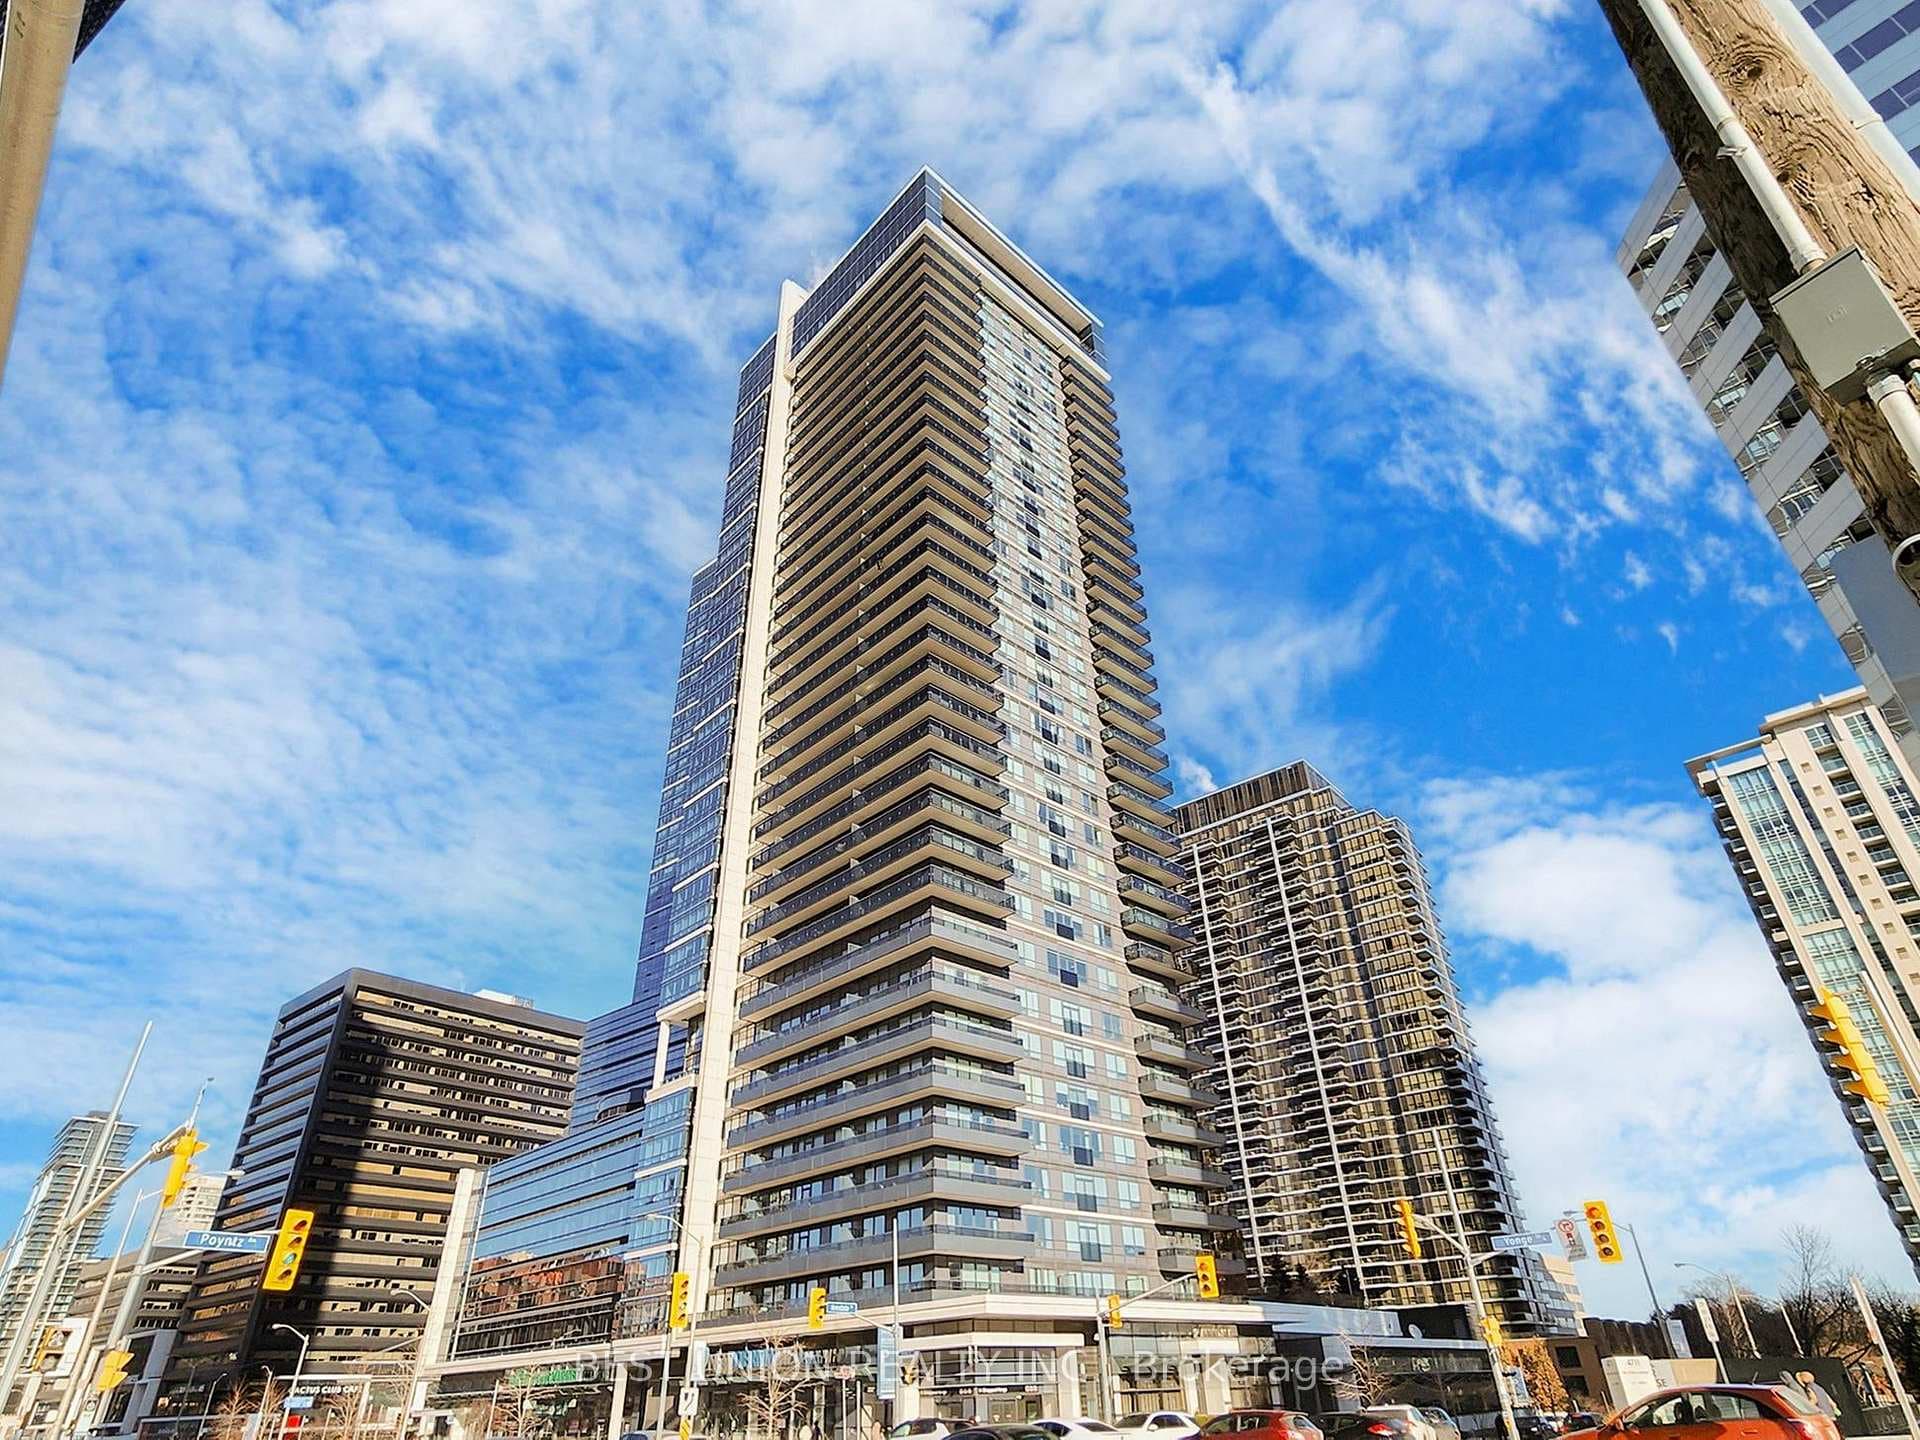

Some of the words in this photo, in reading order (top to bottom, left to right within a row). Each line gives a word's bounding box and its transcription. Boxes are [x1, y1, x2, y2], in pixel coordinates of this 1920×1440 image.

[200, 1233, 244, 1248] Poyntz
[1503, 1235, 1533, 1248] Yonge
[321, 1385, 341, 1394] CLUB
